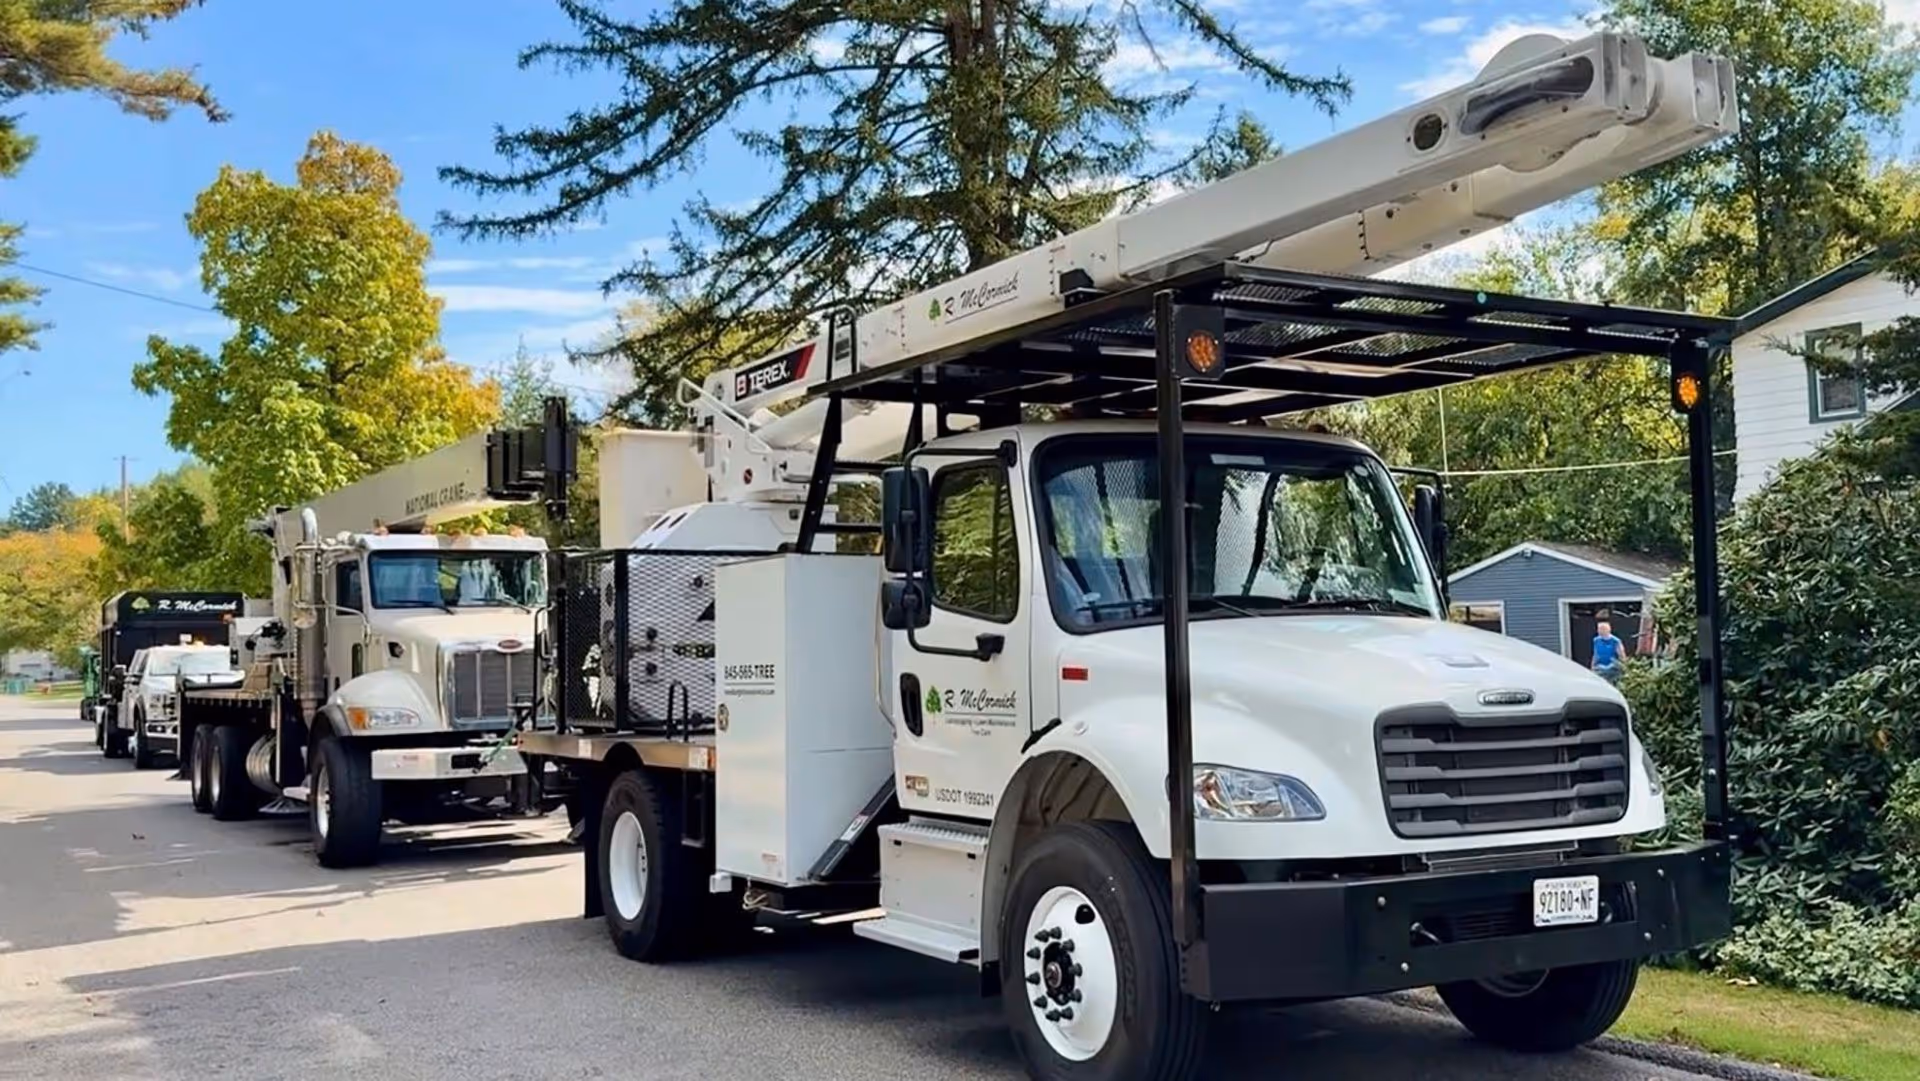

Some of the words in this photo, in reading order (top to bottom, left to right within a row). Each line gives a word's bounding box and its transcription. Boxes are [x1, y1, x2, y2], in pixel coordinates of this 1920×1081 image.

[960, 270, 1019, 309] McCormick
[748, 359, 788, 390] TEREX
[405, 491, 438, 515] NATIONAL
[439, 481, 465, 506] CRANE
[174, 599, 237, 612] McCormick
[960, 688, 1017, 712] McCormick
[935, 787, 962, 803] USDOT
